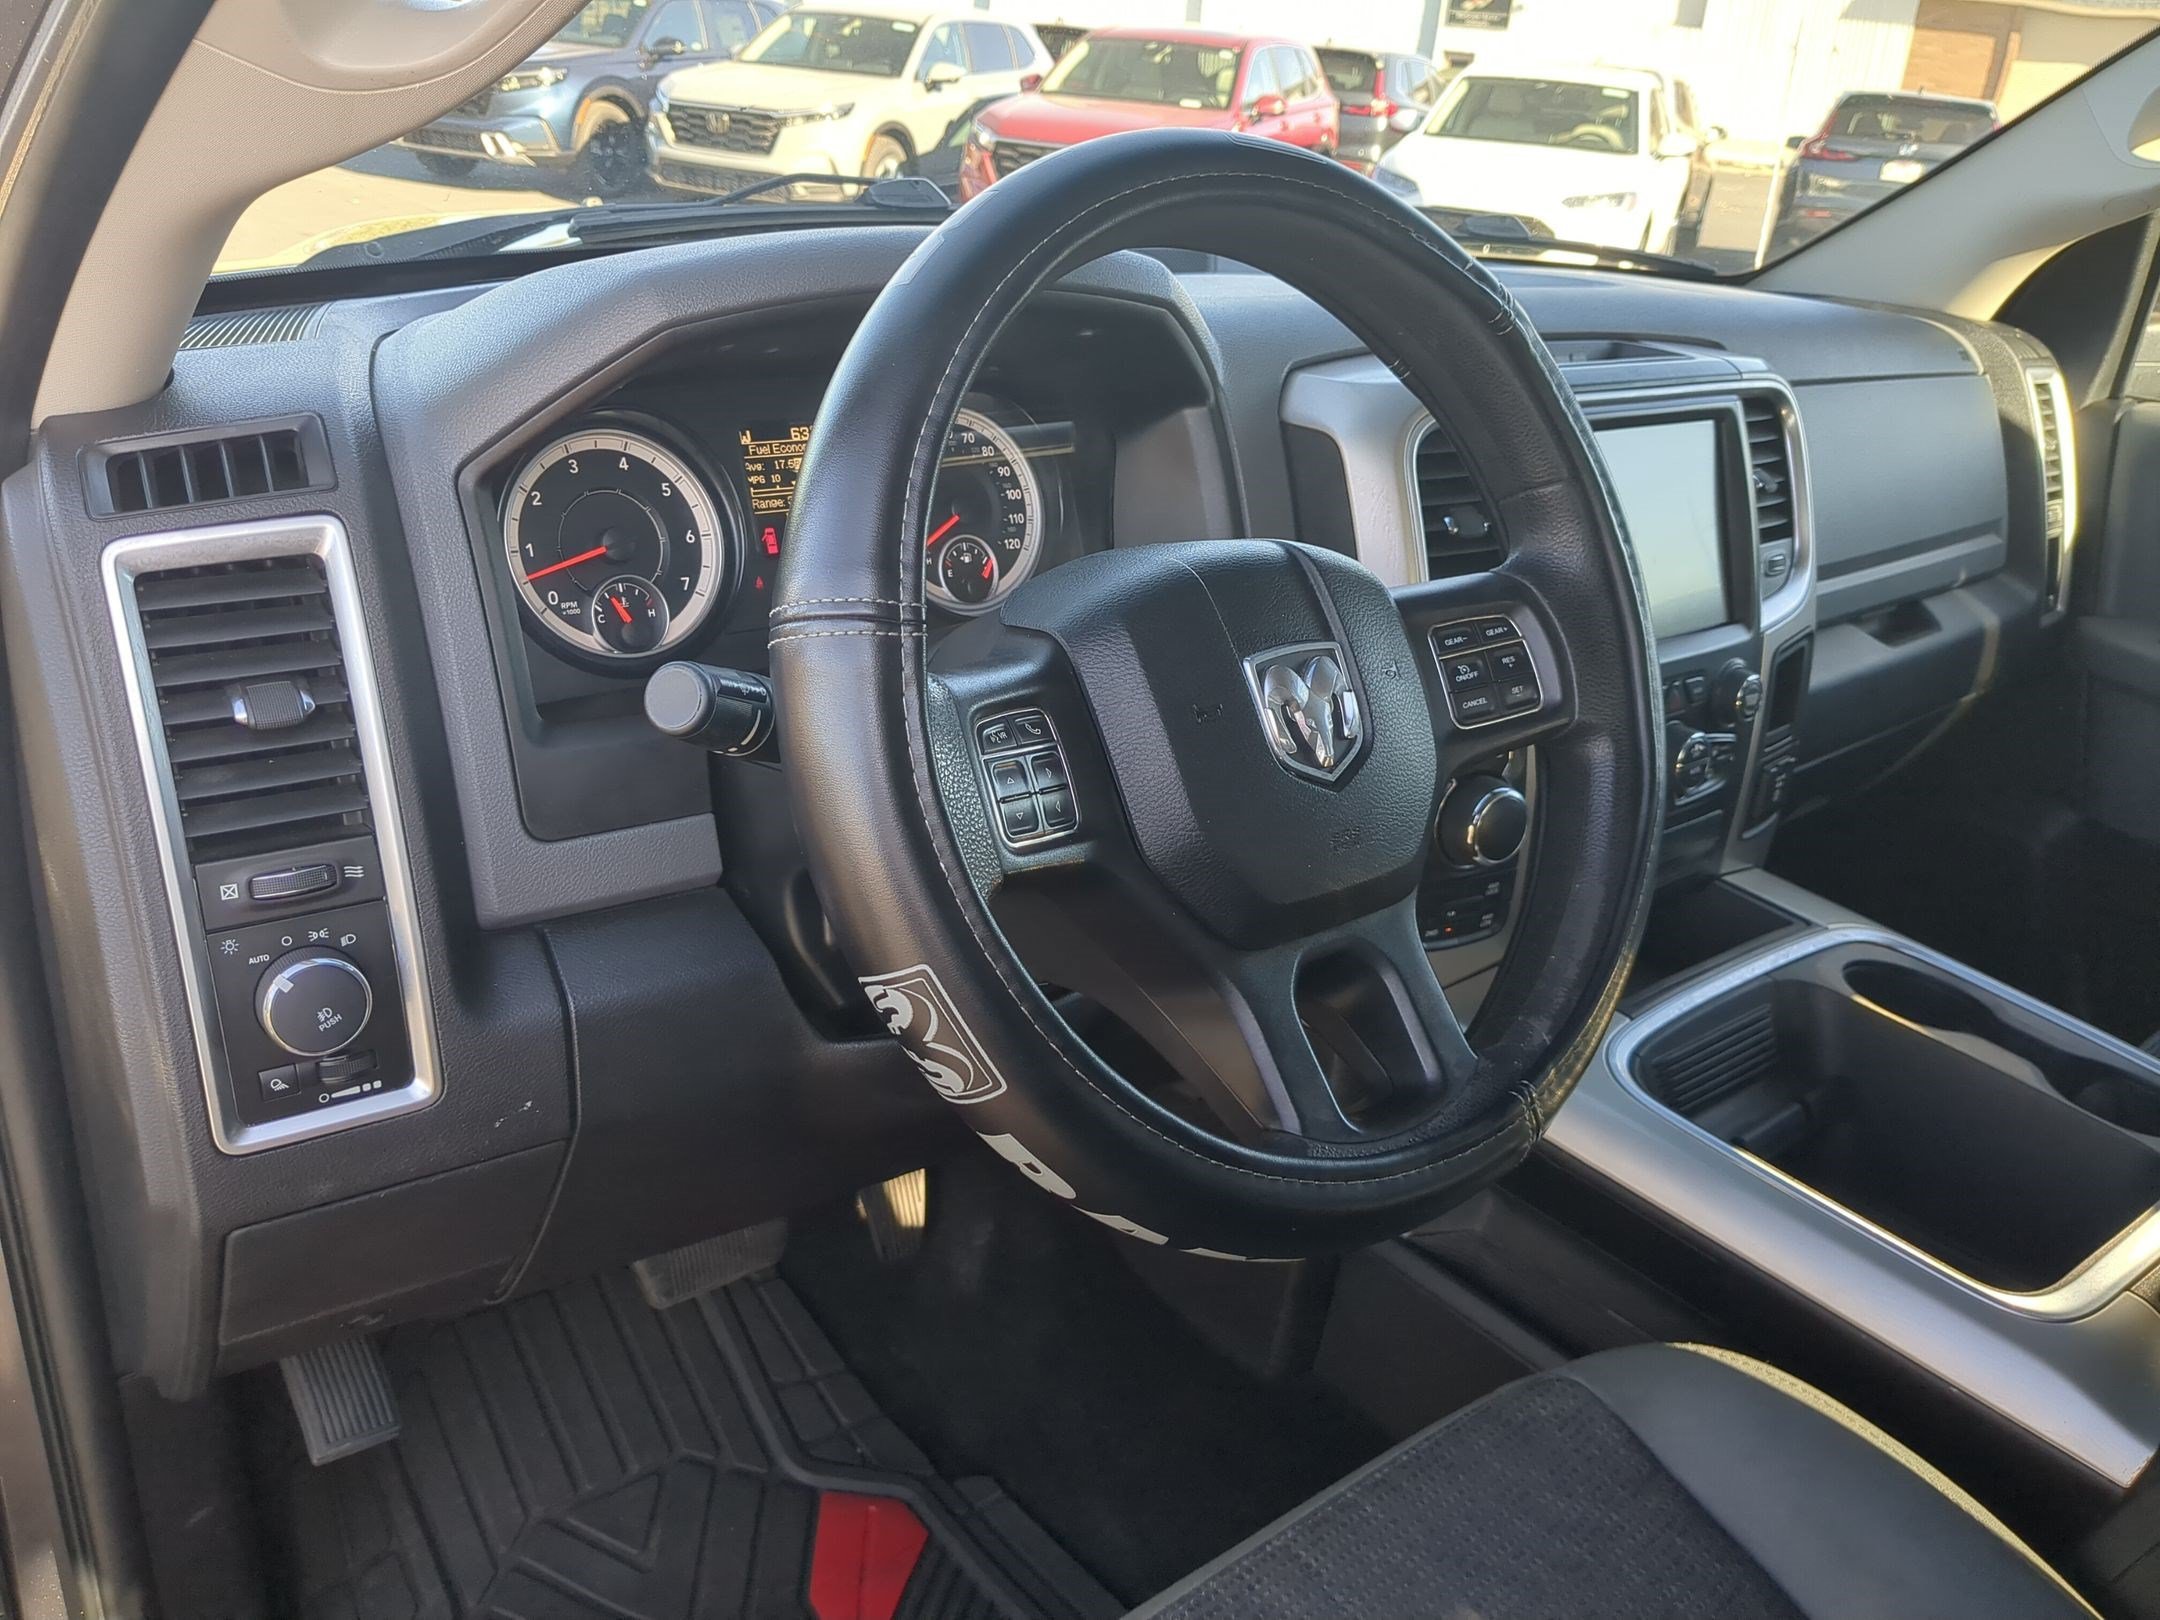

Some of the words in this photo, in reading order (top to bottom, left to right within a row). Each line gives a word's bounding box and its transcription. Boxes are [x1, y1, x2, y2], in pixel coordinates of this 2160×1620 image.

[961, 432, 975, 444] 70
[748, 444, 771, 456] Fuel
[981, 445, 995, 457] 80
[568, 459, 579, 474] 3
[619, 457, 630, 471] 4
[997, 466, 1011, 478] 90
[747, 475, 766, 484] MPG
[771, 473, 782, 483] 10
[661, 482, 672, 497] 5
[1005, 489, 1022, 500] 100
[530, 491, 543, 506] 2
[751, 498, 786, 510] Range:
[1008, 513, 1025, 524] 110
[686, 530, 696, 544] 6
[1004, 538, 1021, 550] 120
[525, 543, 535, 558] 1
[947, 569, 954, 578] E
[680, 577, 691, 591] 7
[548, 591, 559, 605] 0
[561, 600, 578, 610] RPM
[597, 614, 606, 624] C
[648, 608, 656, 618] H
[1511, 685, 1524, 695] SET
[1462, 697, 1488, 709] CANCEL
[248, 953, 270, 965] AUTO
[318, 1013, 343, 1032] PUSH
